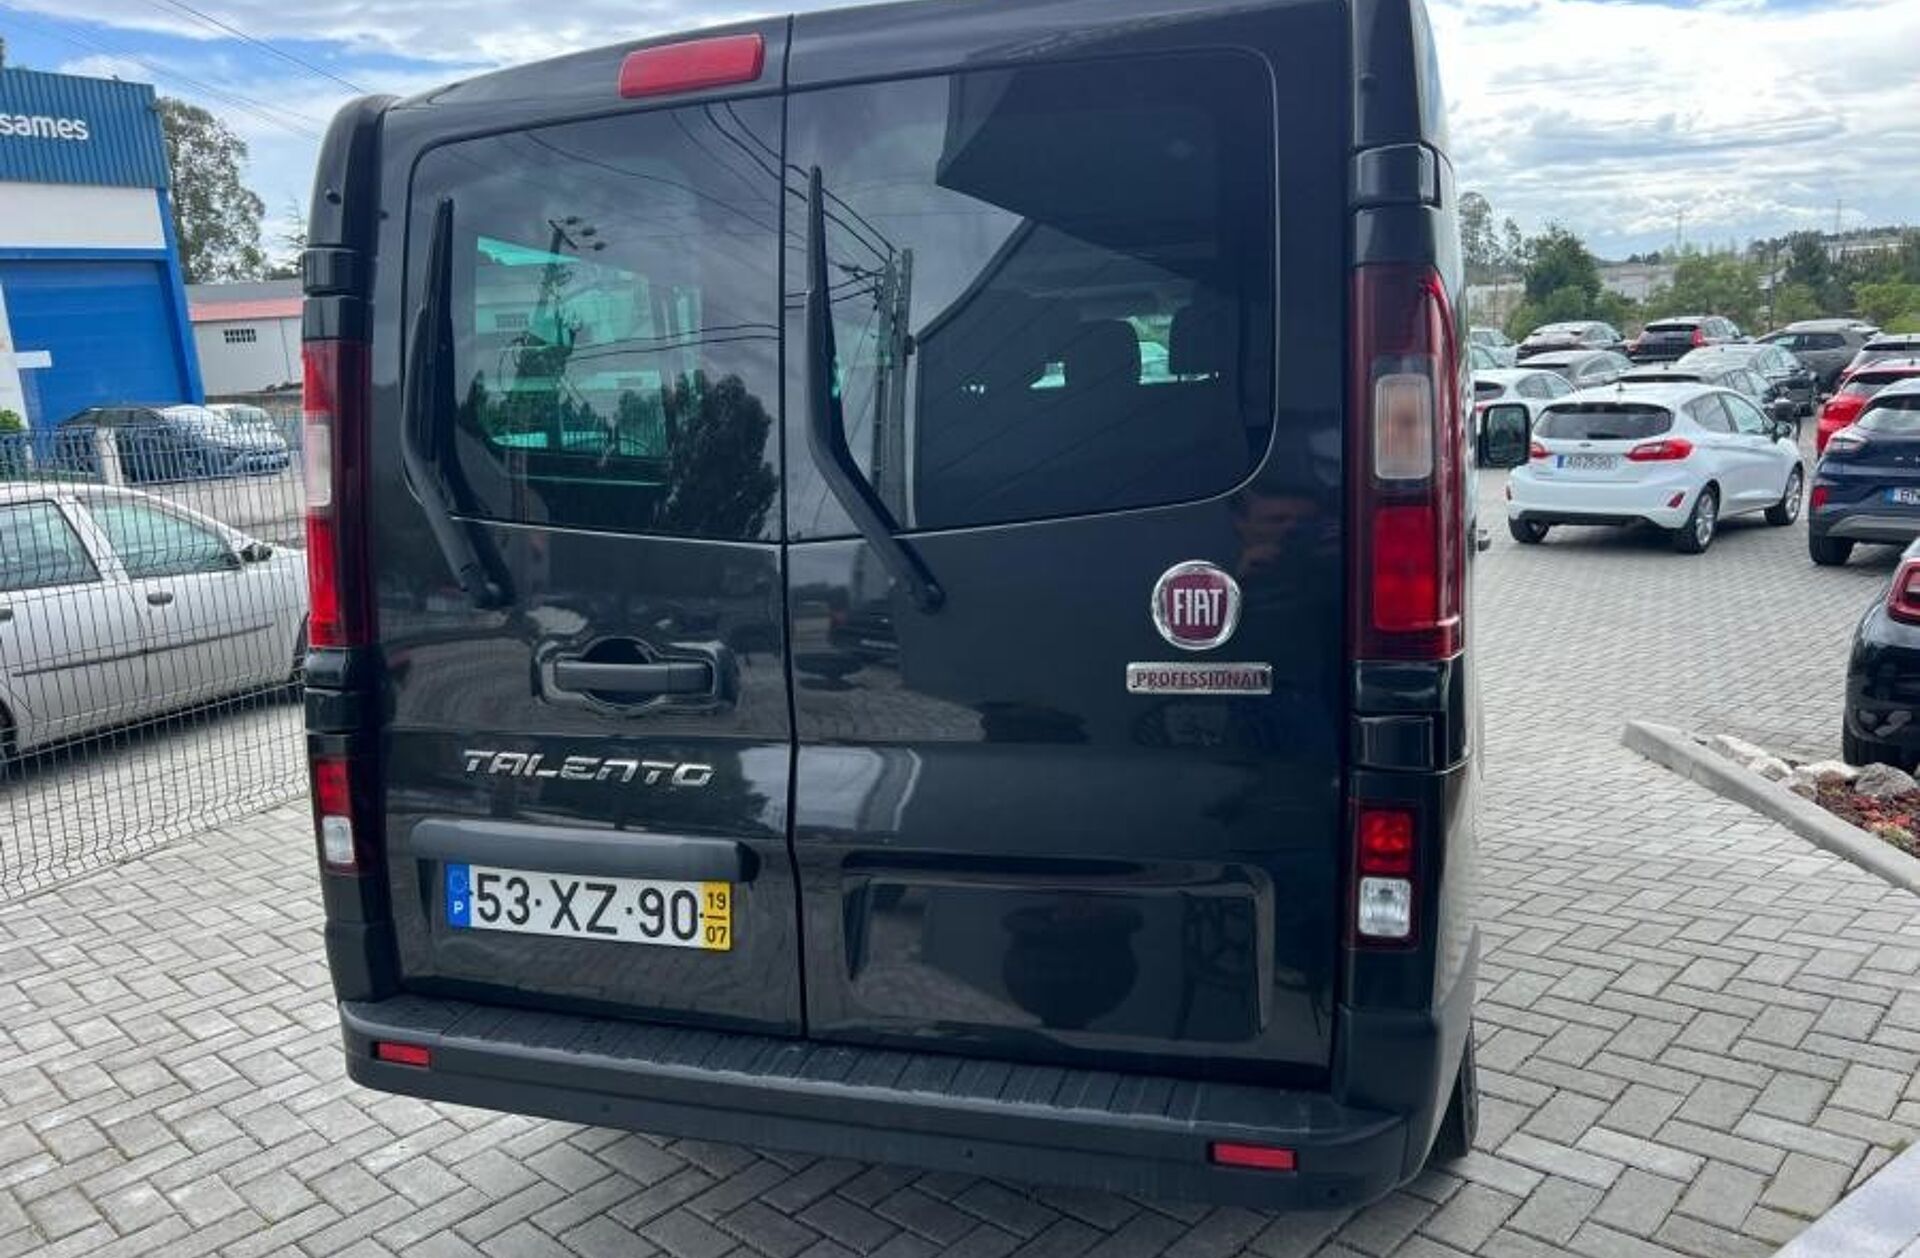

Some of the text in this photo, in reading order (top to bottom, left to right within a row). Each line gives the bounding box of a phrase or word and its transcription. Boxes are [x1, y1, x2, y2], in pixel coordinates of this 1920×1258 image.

[0, 113, 89, 140] sames
[1172, 588, 1223, 627] FIAT
[1135, 670, 1269, 689] PROFESSIONAL
[464, 749, 715, 786] TALENTO
[453, 901, 464, 915] P
[707, 891, 727, 911] 19
[705, 925, 728, 944] 07
